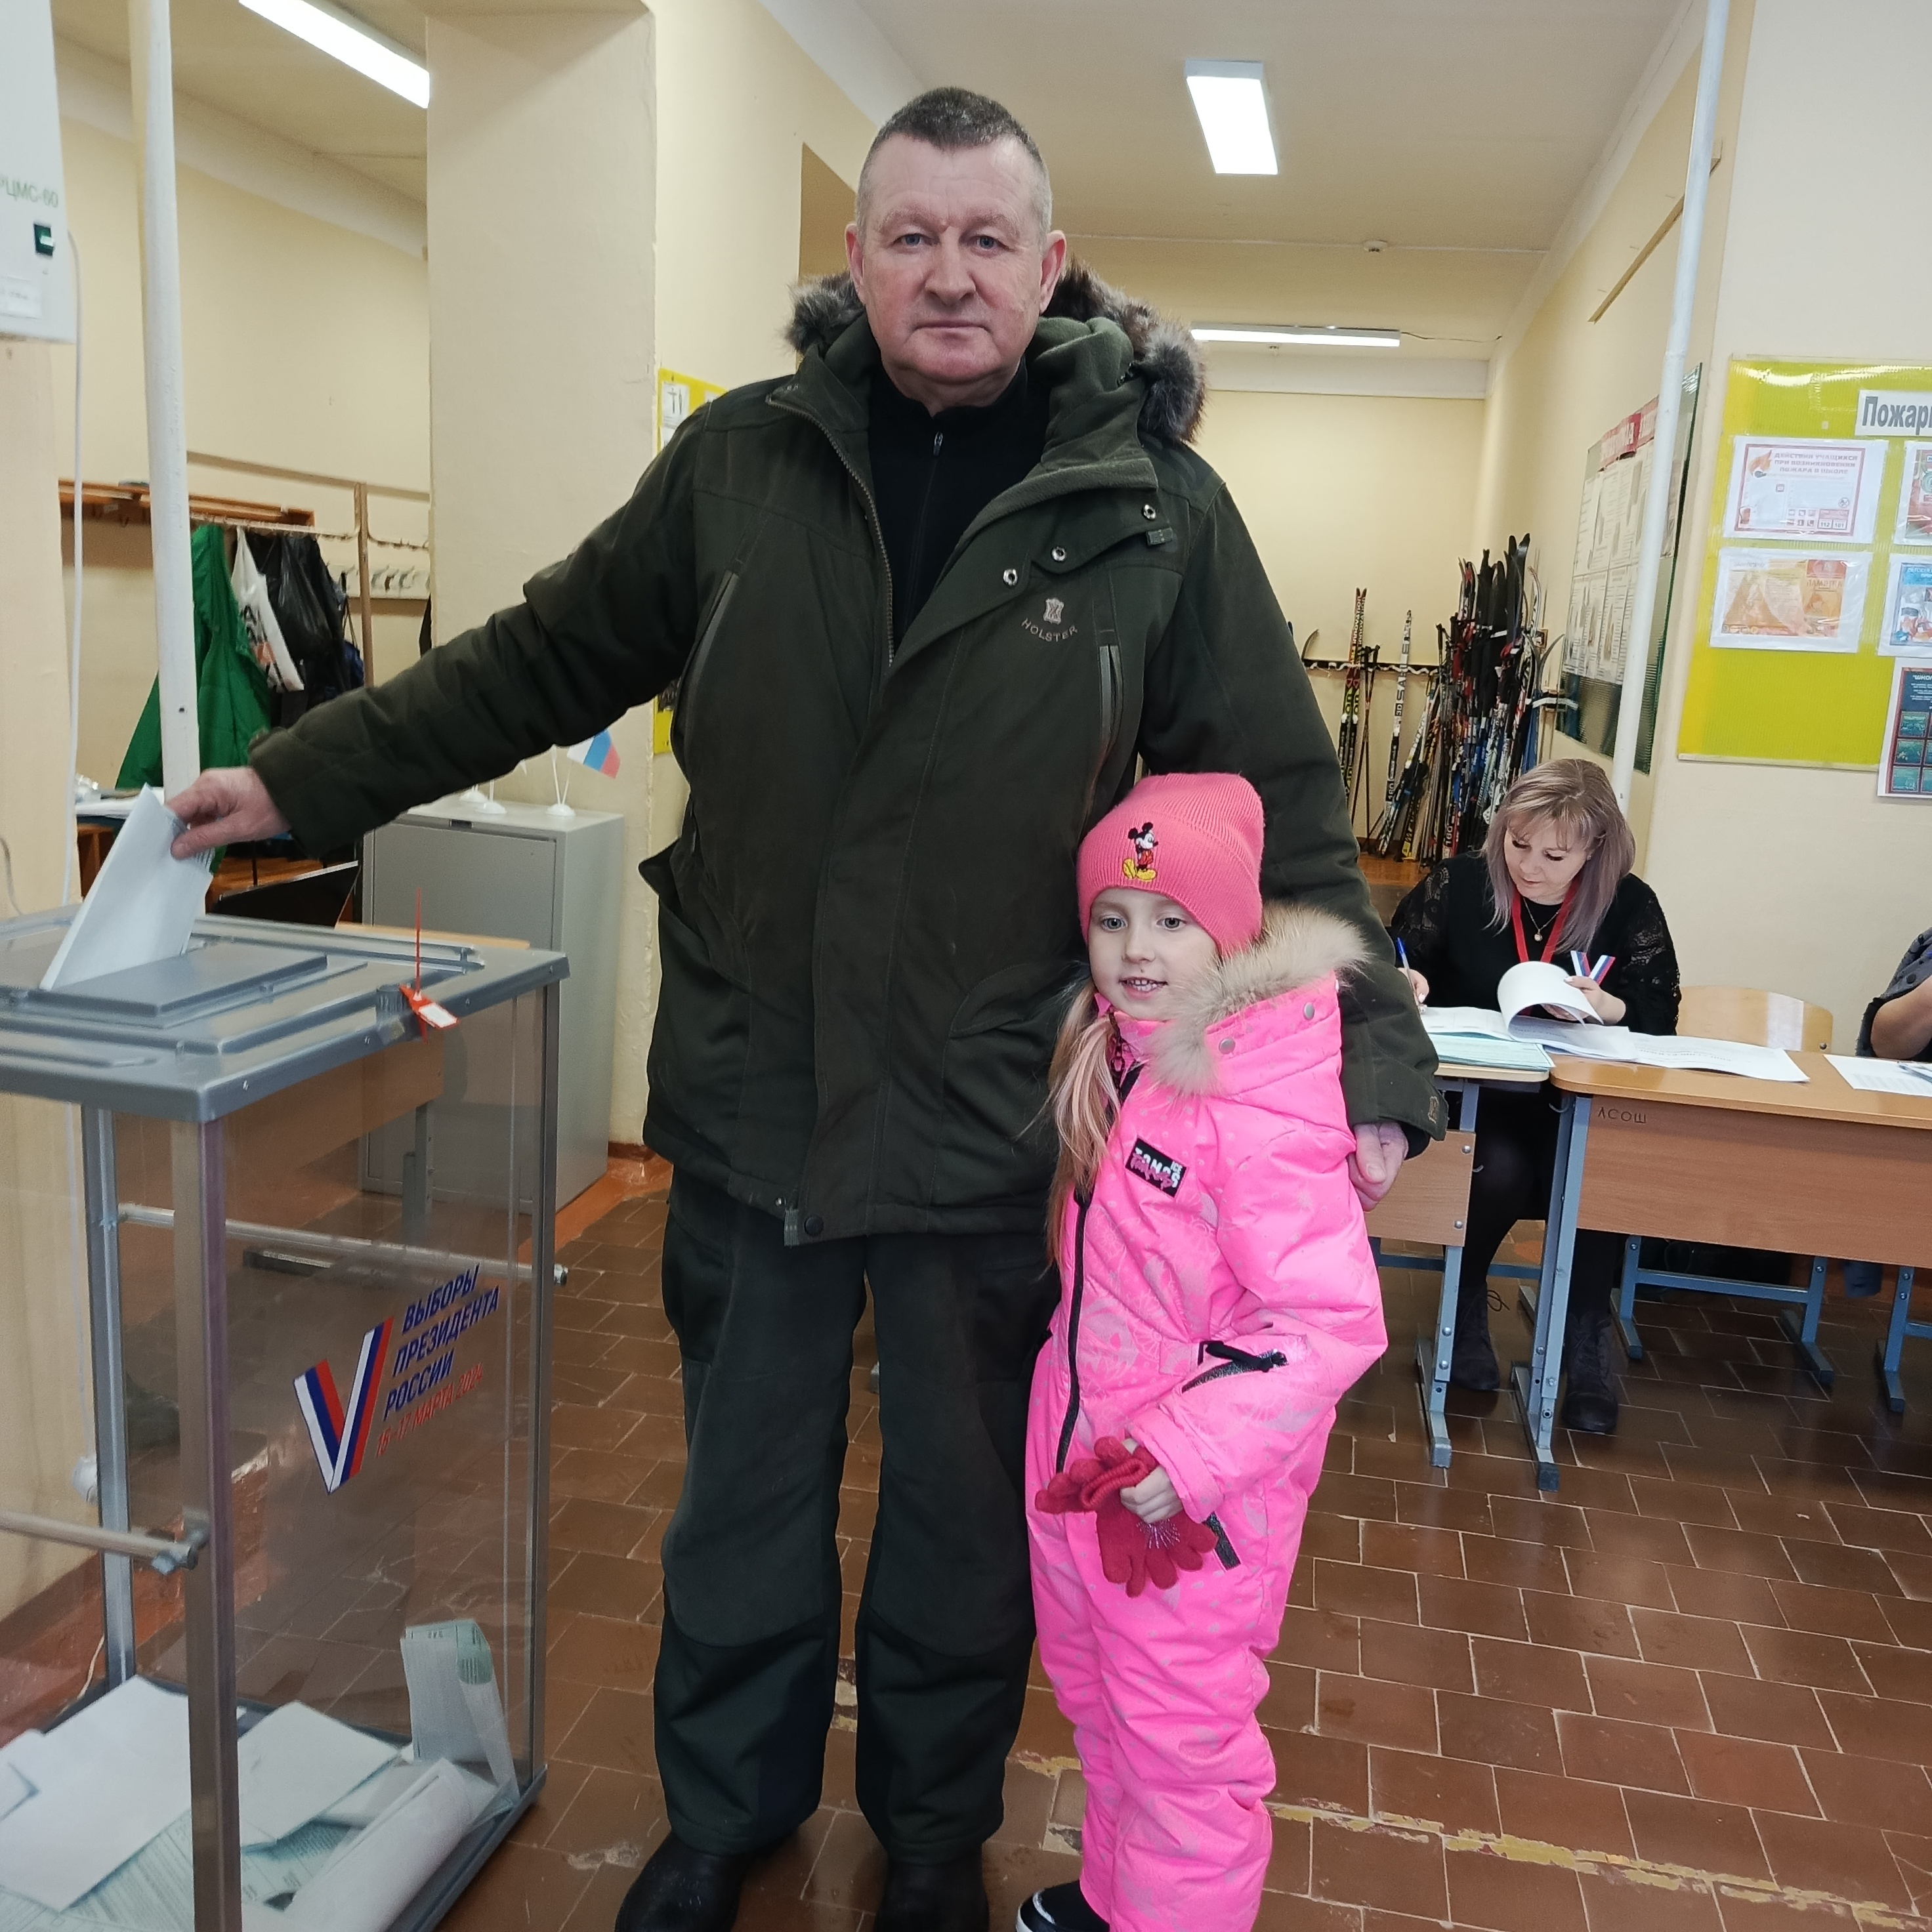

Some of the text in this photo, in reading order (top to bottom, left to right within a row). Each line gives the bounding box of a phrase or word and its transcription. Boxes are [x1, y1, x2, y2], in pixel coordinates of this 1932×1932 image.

[1020, 618, 1078, 642] HOLSTER
[1597, 1106, 1647, 1124] ЛСОШ
[1170, 1161, 1183, 1175] ICE
[402, 1262, 481, 1335] ВЫБОРЫ
[392, 1285, 500, 1377] ПРЕЗИДЕНТА
[383, 1348, 455, 1422] РОССИИ
